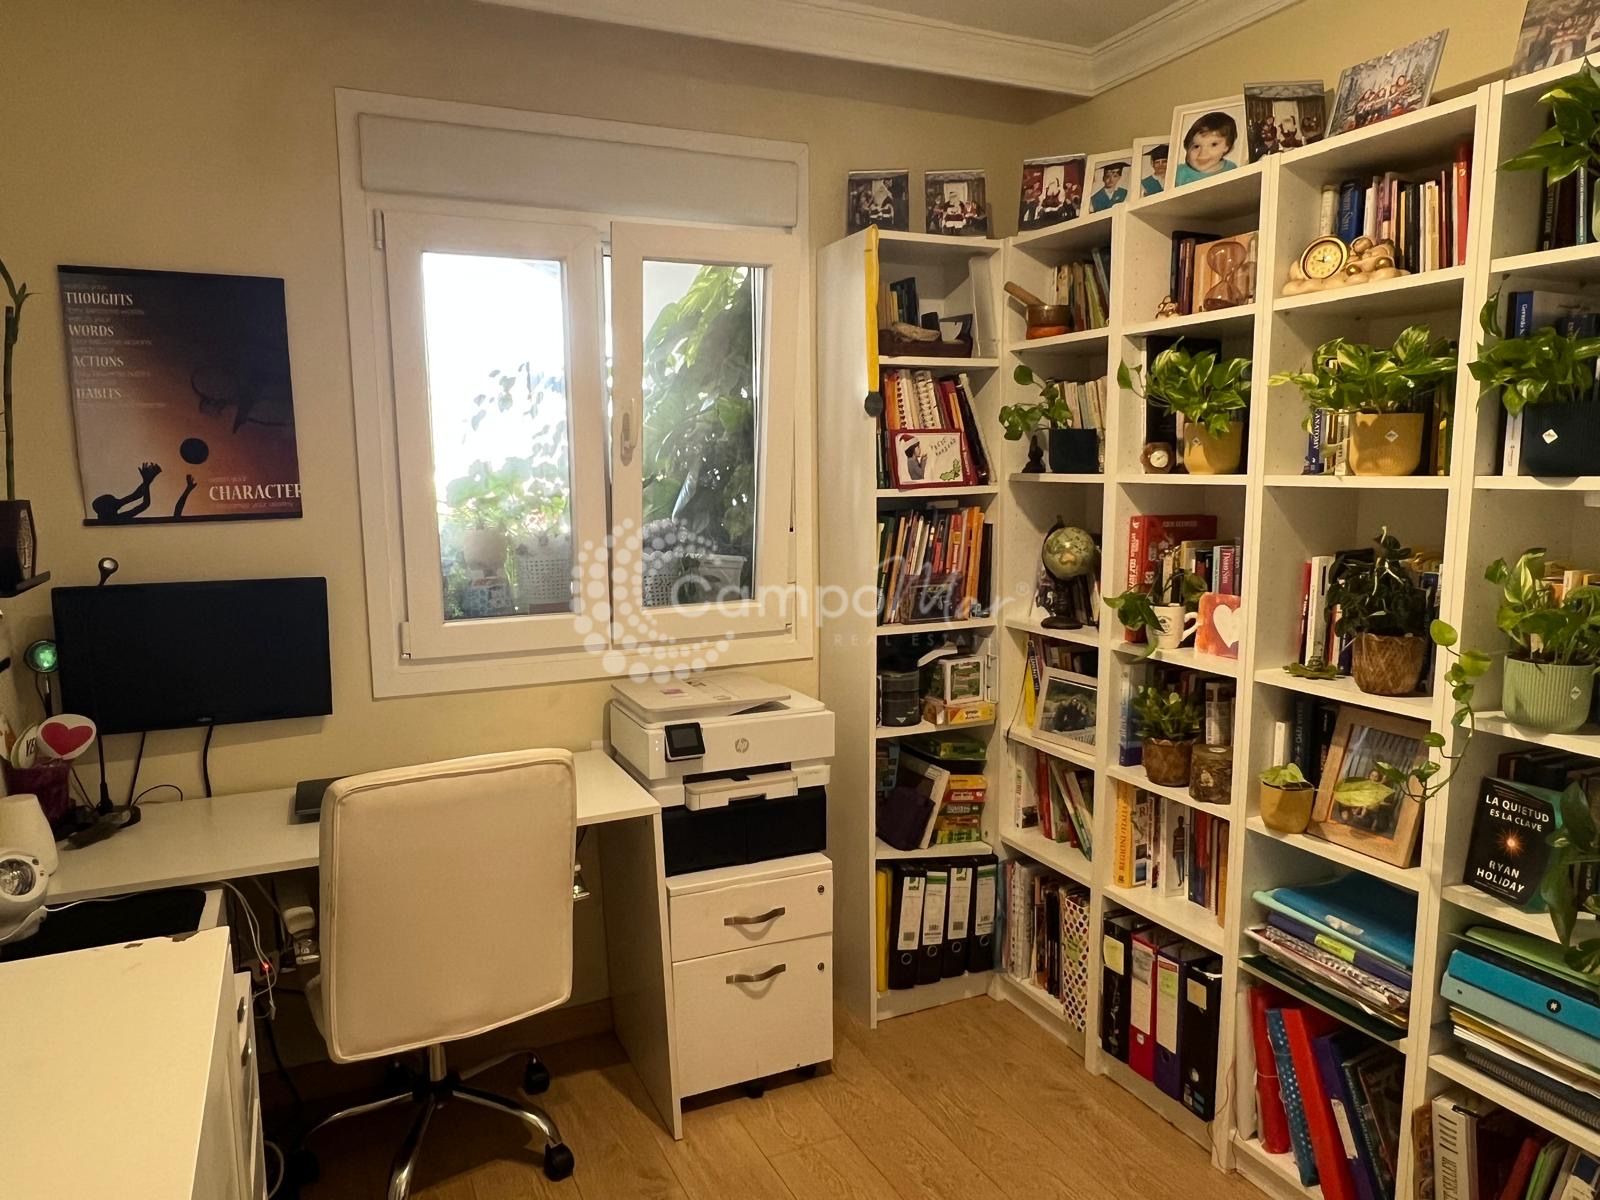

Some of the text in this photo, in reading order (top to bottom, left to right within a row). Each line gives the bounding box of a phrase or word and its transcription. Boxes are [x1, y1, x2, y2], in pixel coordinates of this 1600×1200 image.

[64, 291, 134, 306] THOUGHTS
[68, 324, 114, 337] WORDS
[73, 355, 124, 367] ACTIONS
[76, 387, 122, 399] HABITS
[1485, 794, 1550, 823] LA QUIETUD
[1489, 808, 1542, 832] ES LA CLAVE
[1488, 860, 1520, 879] RYAN
[1476, 867, 1525, 894] HOLIDAY
